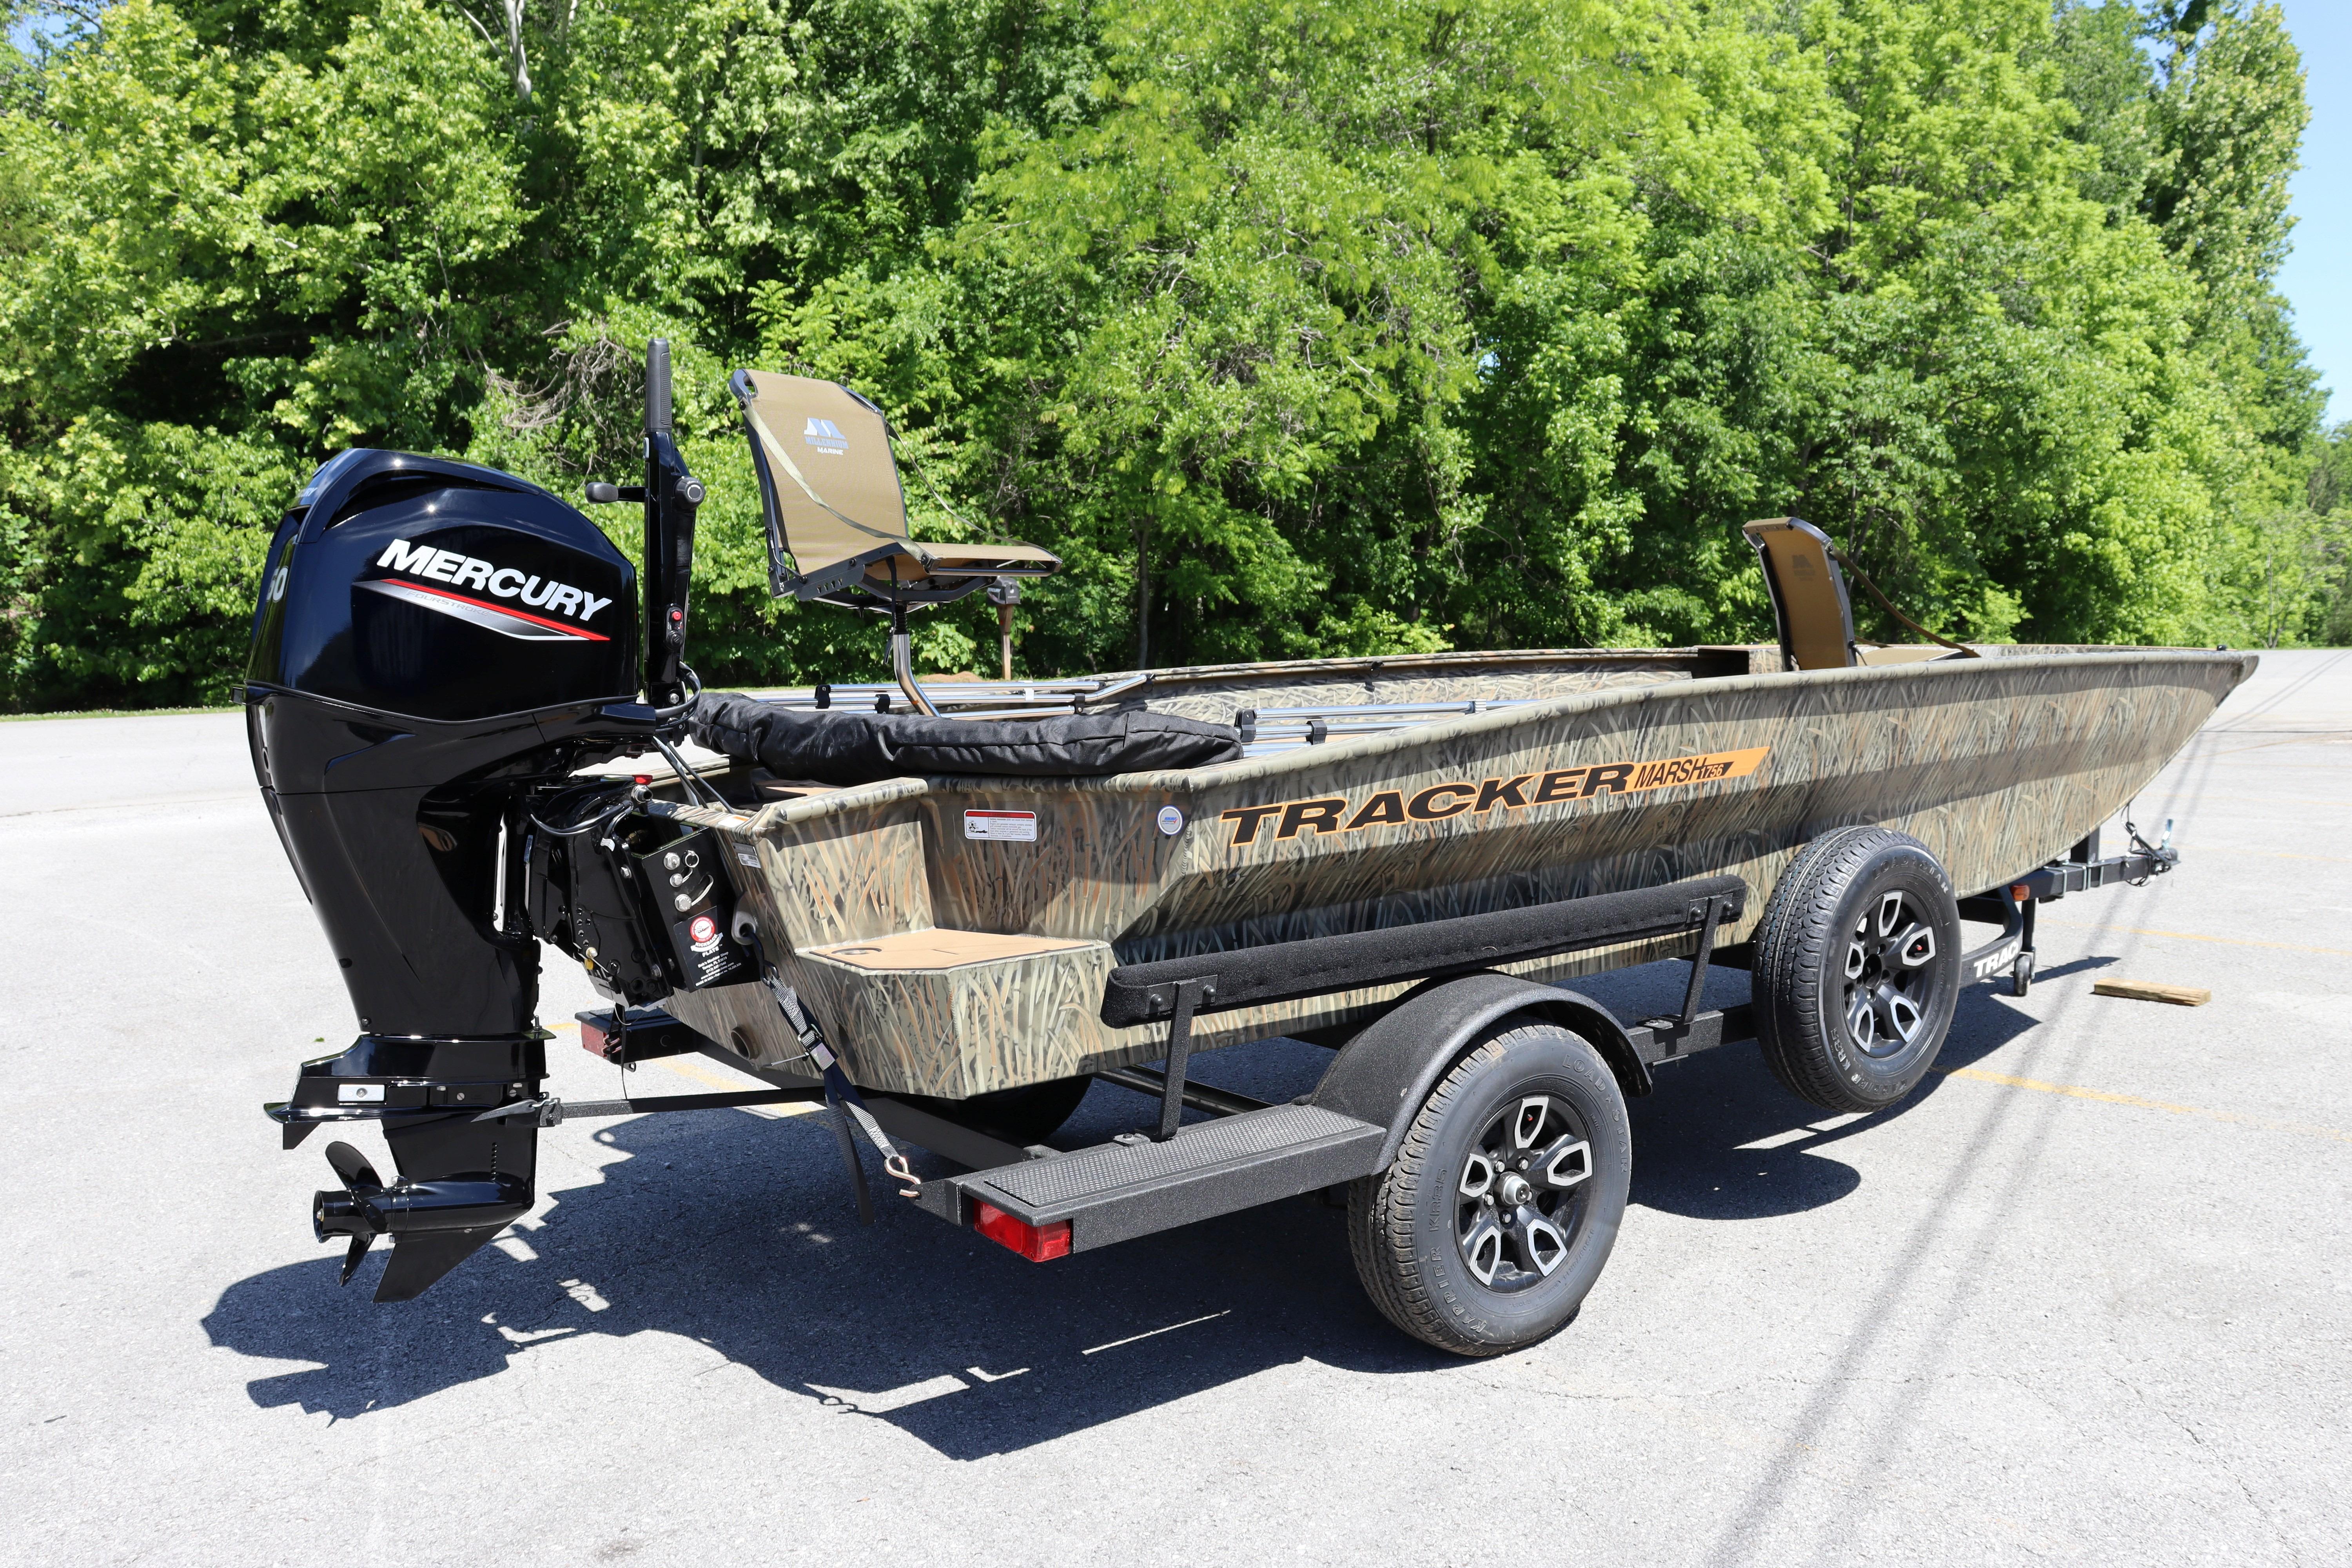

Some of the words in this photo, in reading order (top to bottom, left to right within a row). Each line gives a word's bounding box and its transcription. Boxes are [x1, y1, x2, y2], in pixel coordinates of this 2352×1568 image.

[805, 436, 849, 449] MILLENNIUM
[817, 447, 844, 455] MARINE
[377, 539, 612, 621] MERCURY
[1219, 761, 1635, 847] TRACKER
[1633, 757, 1708, 789] MARSH
[1699, 764, 1724, 779] 1756
[1872, 854, 1909, 880] LOAD
[1919, 860, 1949, 894] STAR
[695, 934, 719, 947] KICKBACK
[702, 946, 719, 957] PLATE
[1562, 1054, 1606, 1092] LOAD
[1612, 1109, 1628, 1174] STAR
[1429, 1168, 1448, 1232] KR35
[1430, 1245, 1488, 1334] KARRIER
